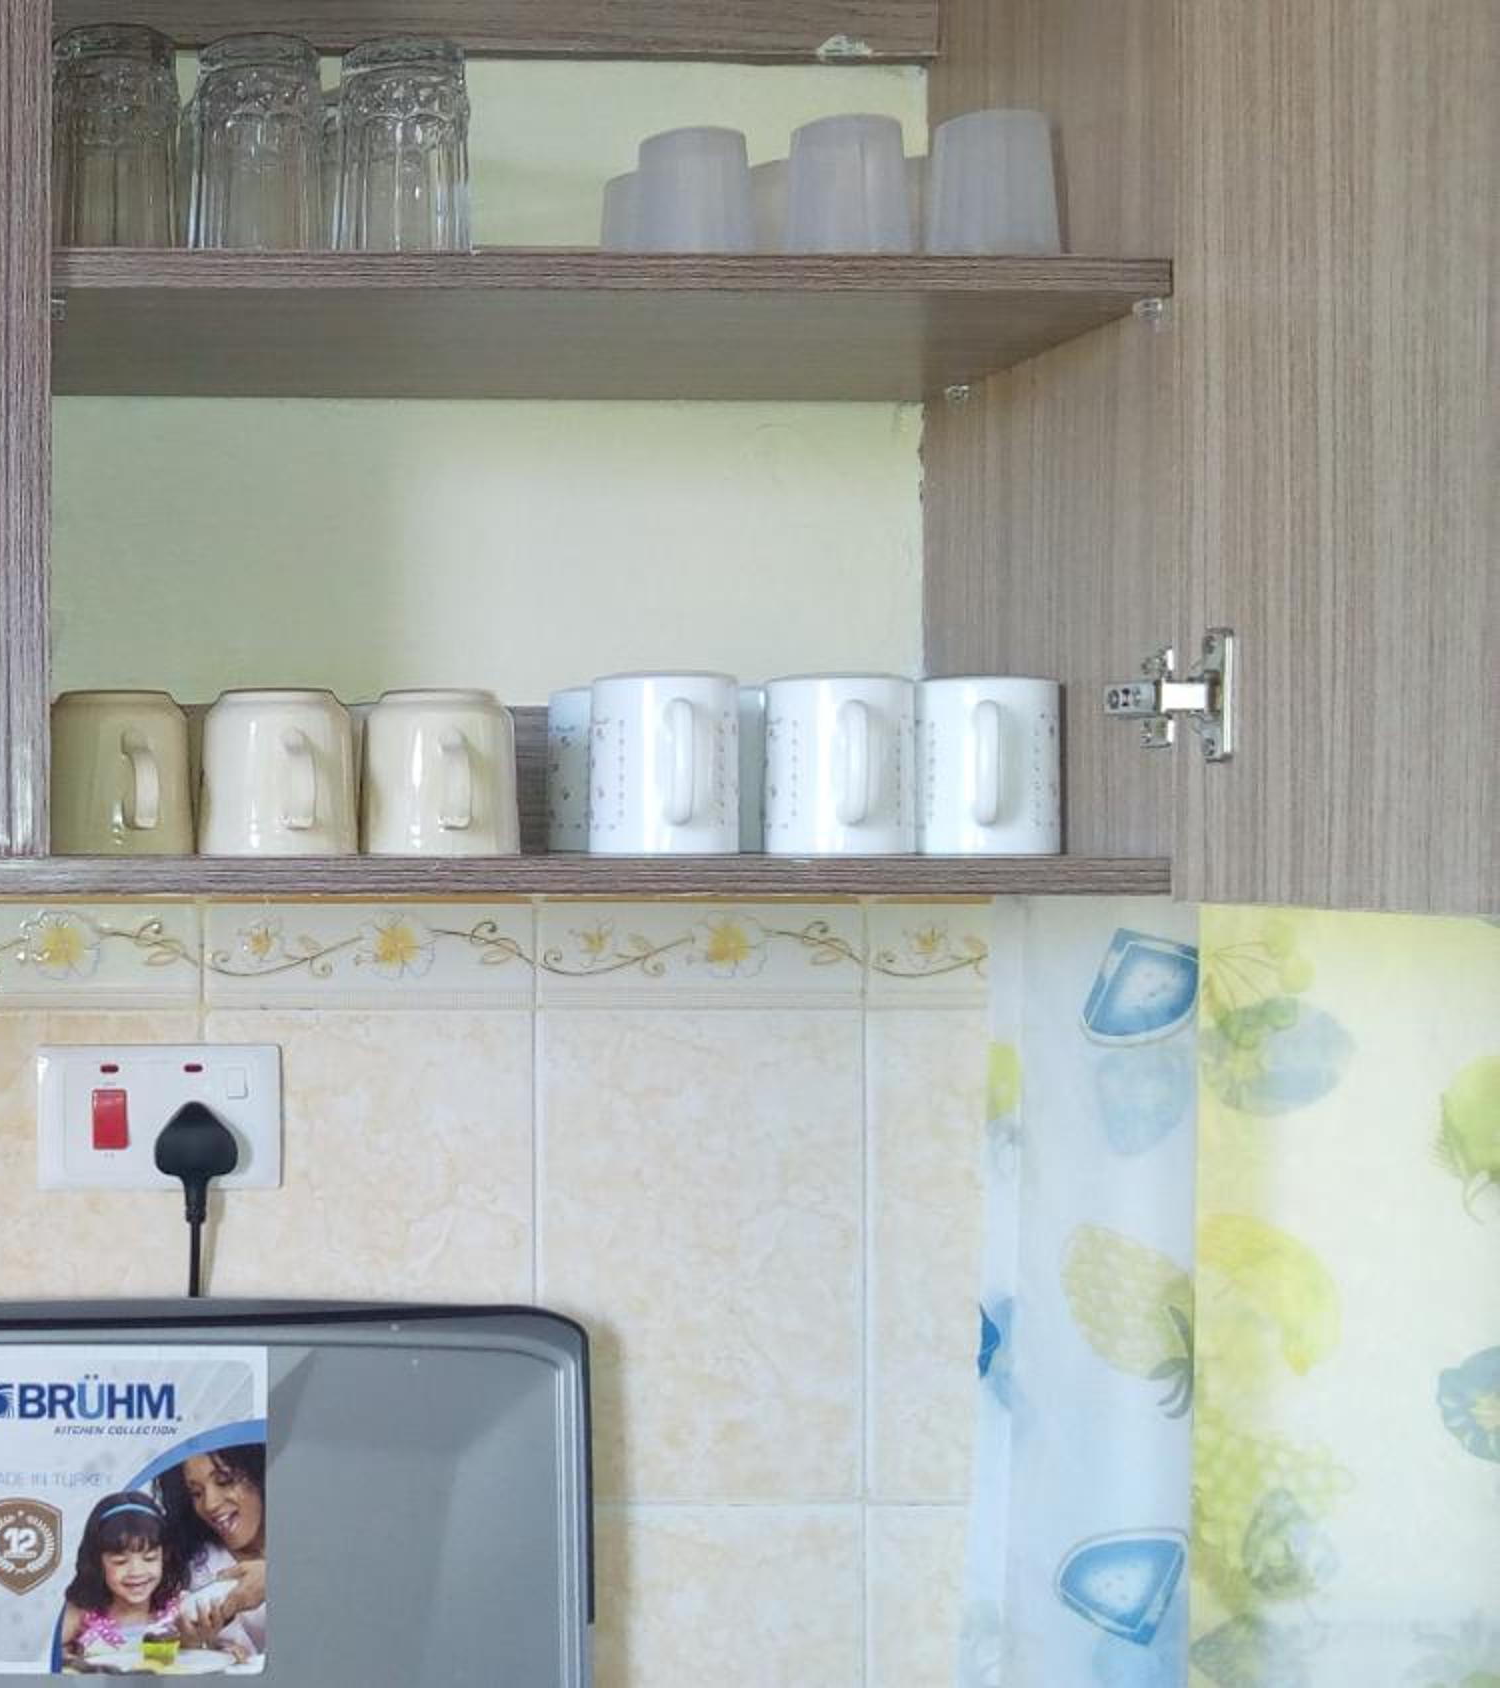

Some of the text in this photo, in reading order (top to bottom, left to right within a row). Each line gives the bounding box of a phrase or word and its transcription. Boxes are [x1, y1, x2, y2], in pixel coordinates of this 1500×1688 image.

[54, 1425, 178, 1435] KITCHEN COLLECTION
[31, 1472, 48, 1486] IN
[53, 1472, 113, 1487] TURKEY
[4, 1528, 37, 1553] 12
